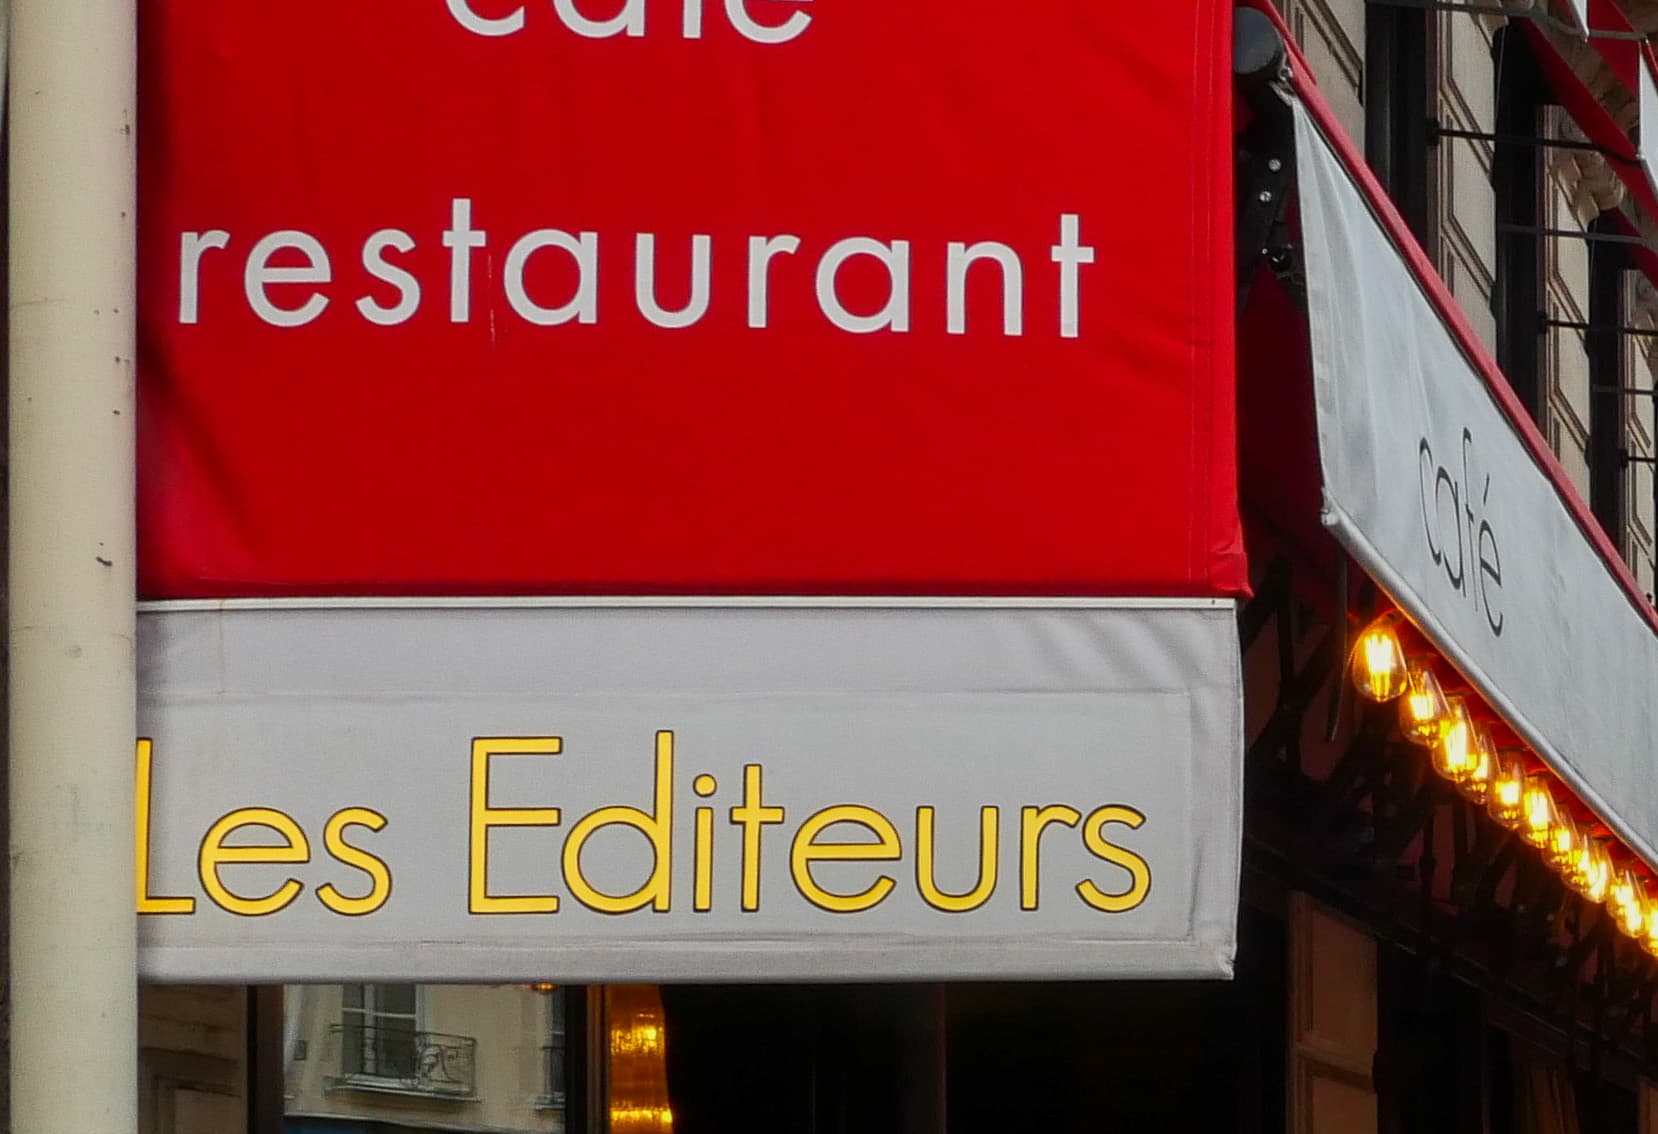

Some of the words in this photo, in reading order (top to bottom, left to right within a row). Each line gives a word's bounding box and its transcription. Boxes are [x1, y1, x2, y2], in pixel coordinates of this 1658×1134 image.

[177, 198, 1096, 338] restaurant
[1418, 426, 1504, 638] café
[136, 738, 392, 916] Les
[468, 730, 1153, 916] Editeurs
